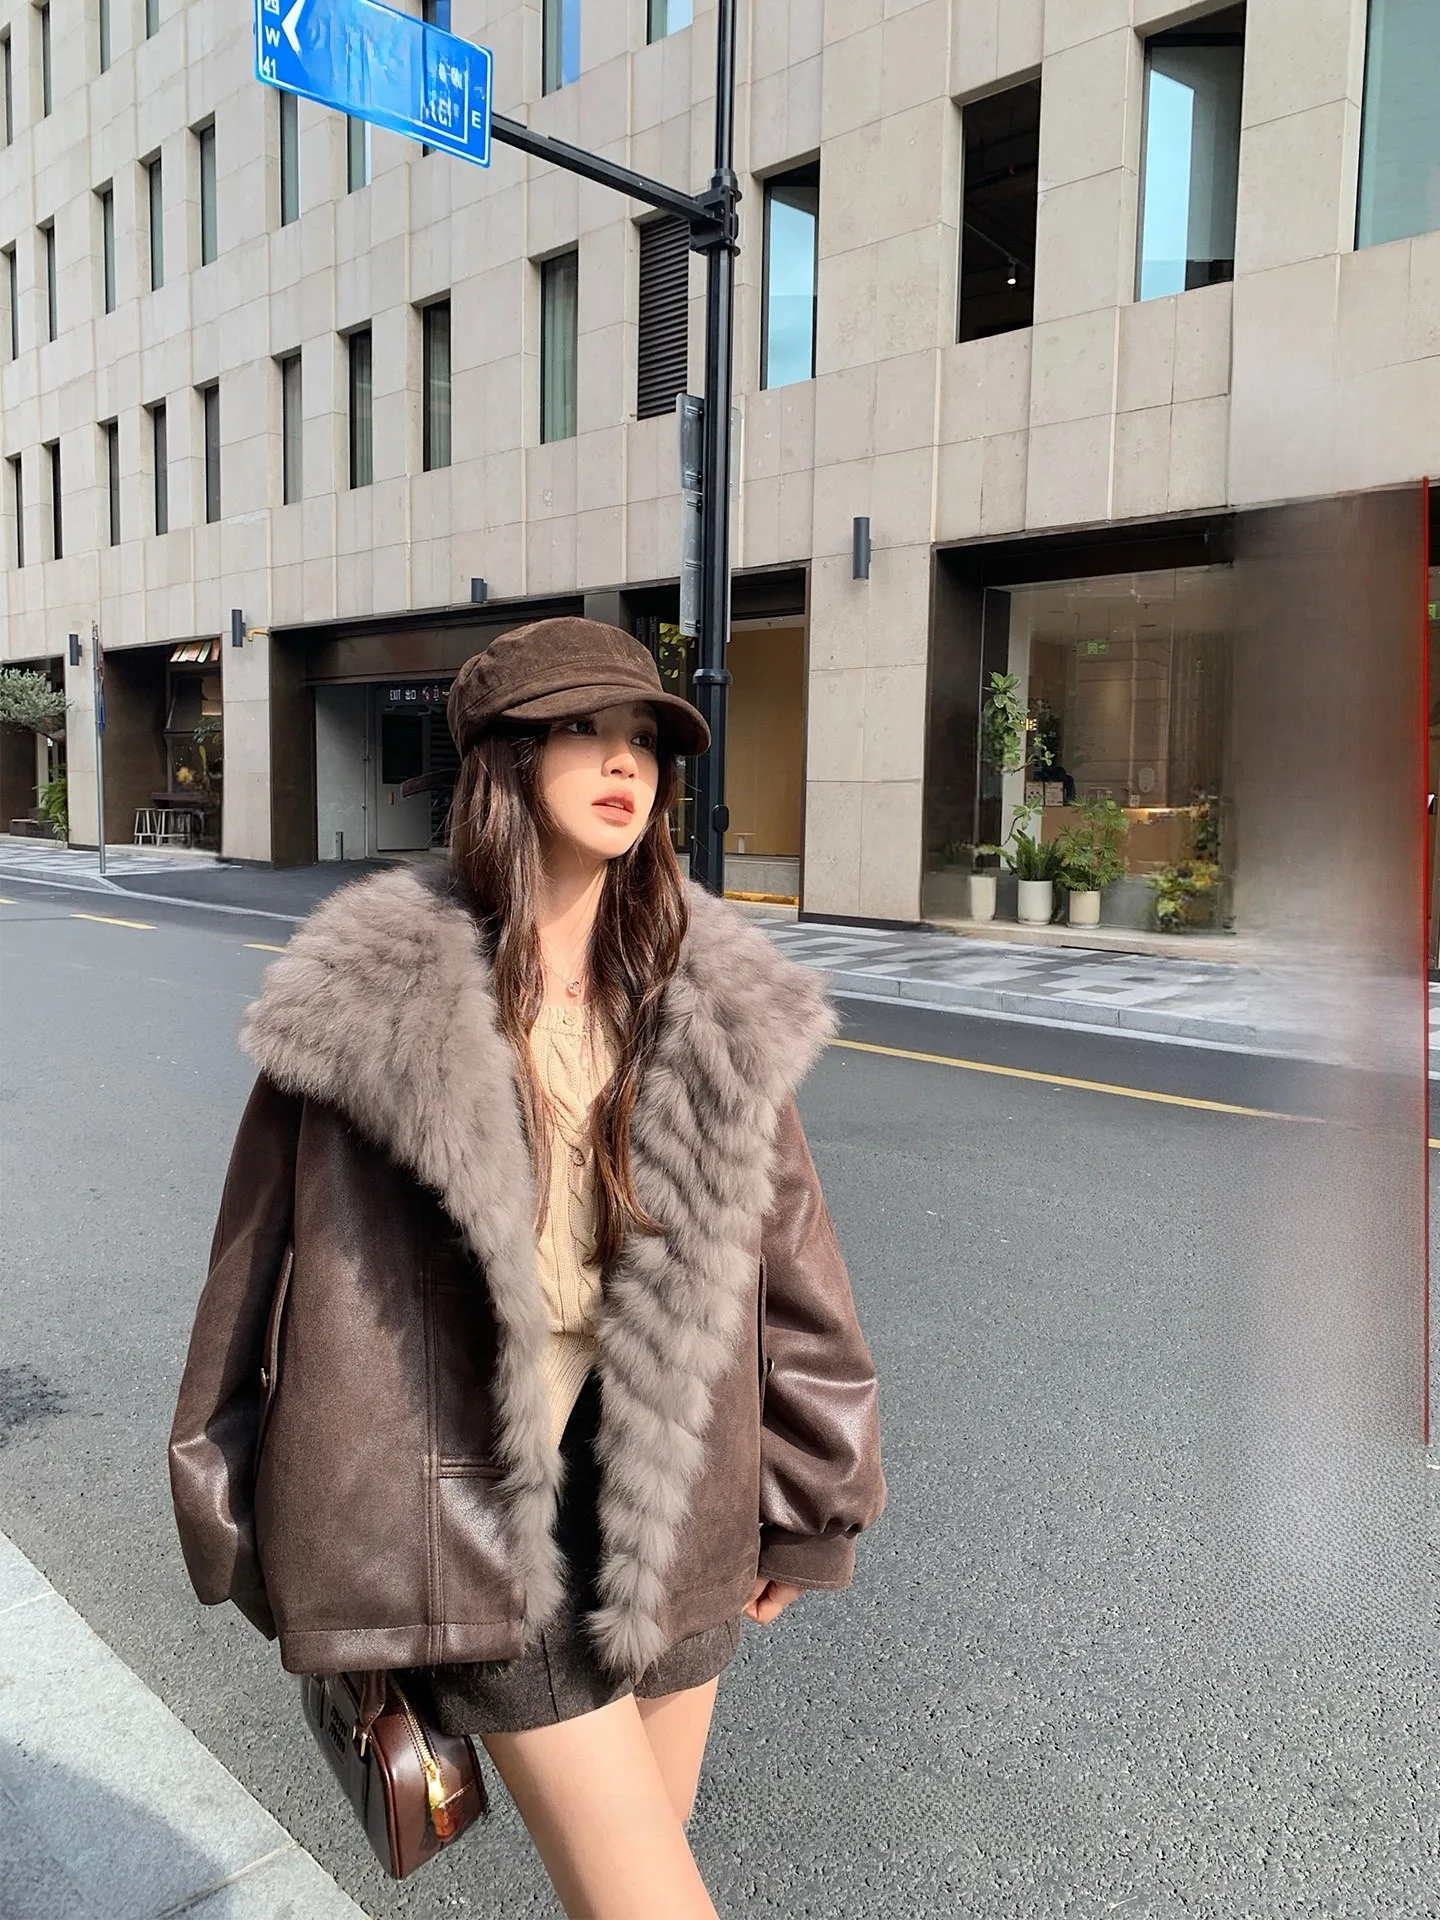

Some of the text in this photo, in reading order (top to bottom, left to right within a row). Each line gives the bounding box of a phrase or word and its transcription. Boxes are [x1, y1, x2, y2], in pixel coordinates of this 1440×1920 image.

[265, 25, 280, 48] W
[263, 55, 277, 79] 41
[471, 110, 482, 129] E
